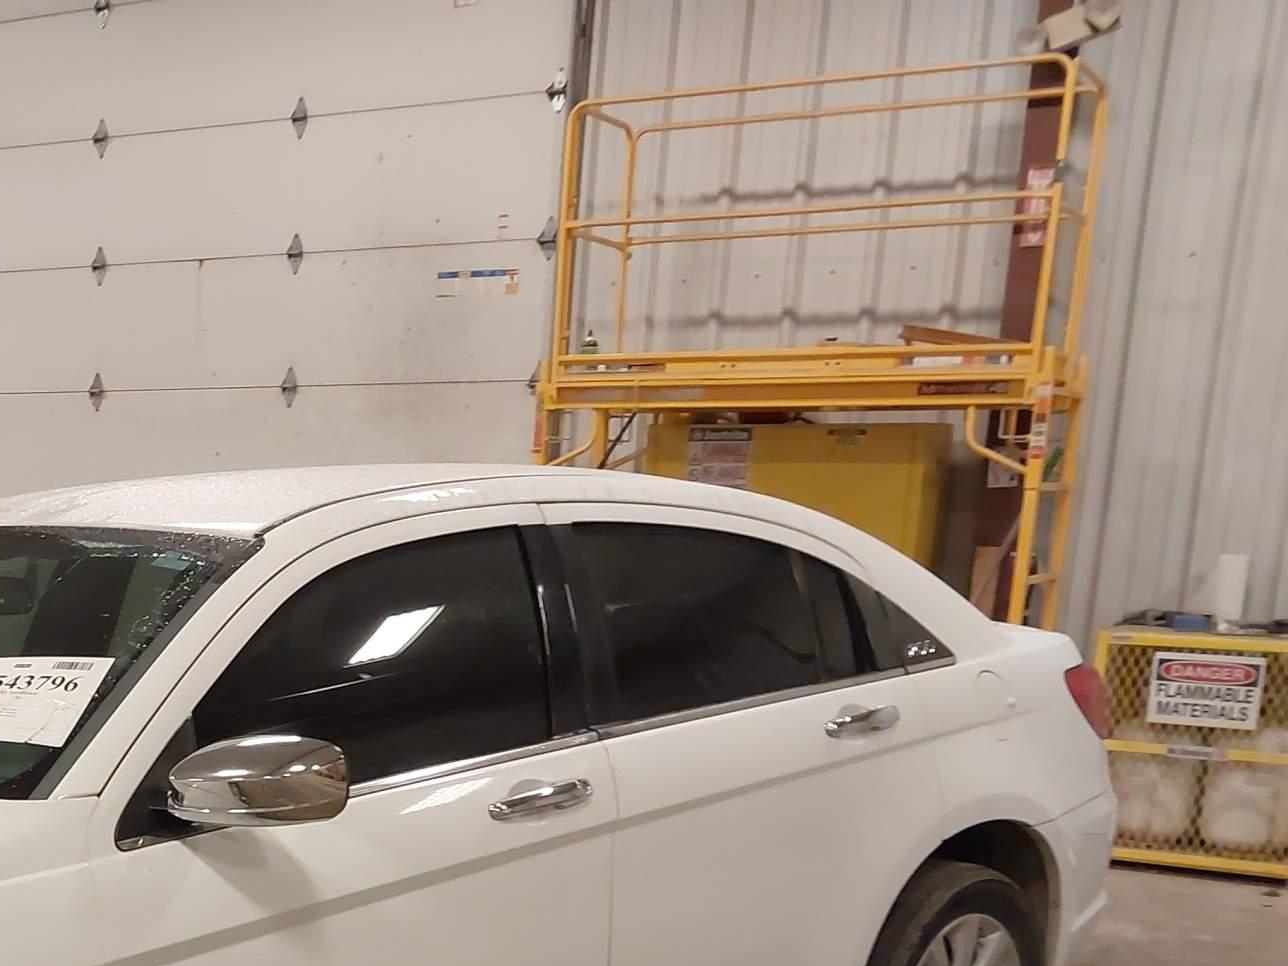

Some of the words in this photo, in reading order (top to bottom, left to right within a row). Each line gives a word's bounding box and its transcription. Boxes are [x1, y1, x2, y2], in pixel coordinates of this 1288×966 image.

[1171, 664, 1246, 681] DANGER
[1156, 682, 1255, 704] FLAMMABLE
[1156, 700, 1250, 722] MATERIALS
